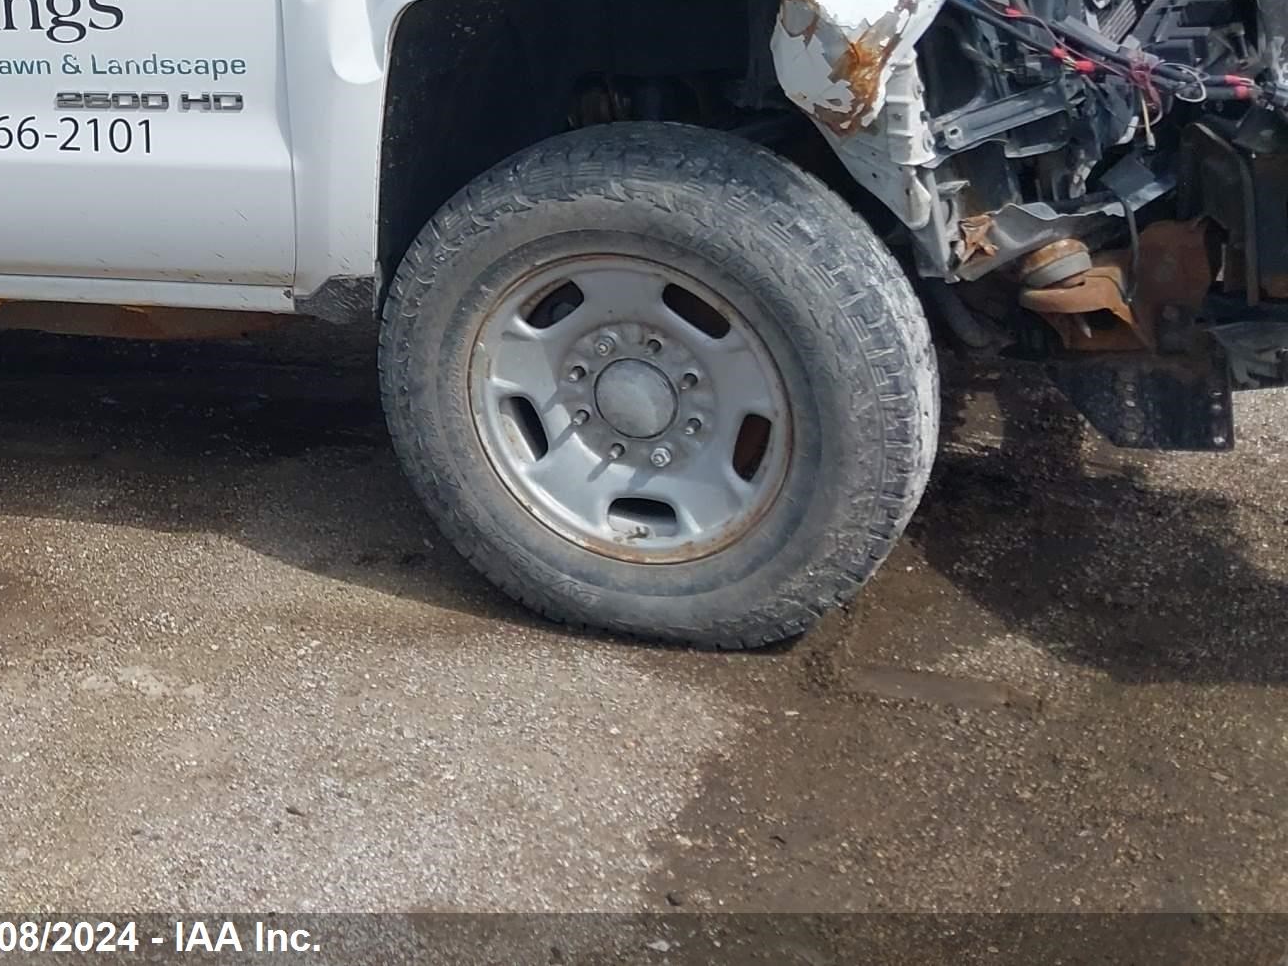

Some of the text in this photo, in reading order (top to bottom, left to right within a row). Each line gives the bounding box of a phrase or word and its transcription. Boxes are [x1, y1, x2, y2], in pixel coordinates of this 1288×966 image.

[61, 53, 83, 75] &
[91, 53, 247, 81] Landscape
[55, 91, 244, 111] 2500 HD
